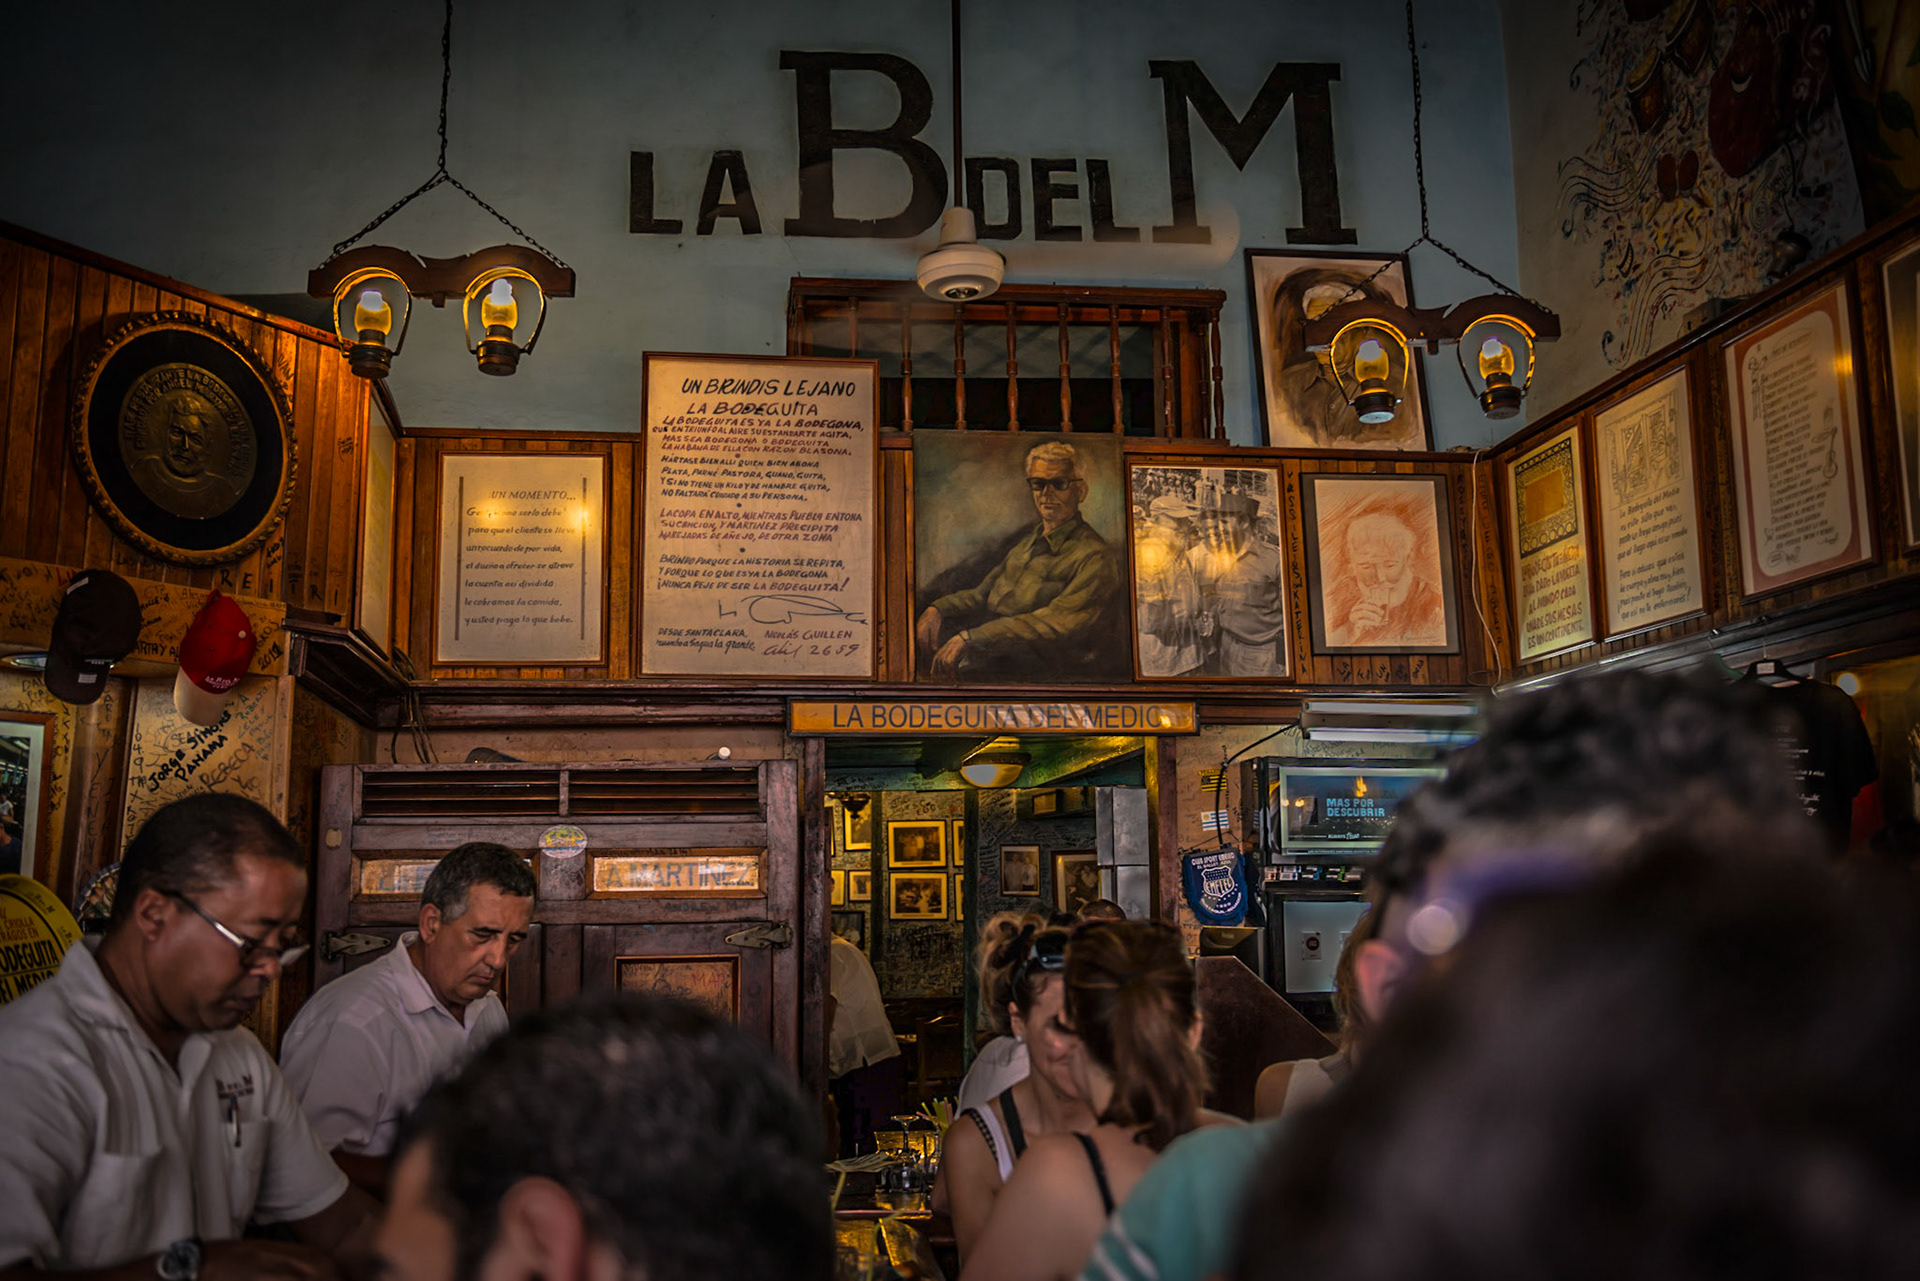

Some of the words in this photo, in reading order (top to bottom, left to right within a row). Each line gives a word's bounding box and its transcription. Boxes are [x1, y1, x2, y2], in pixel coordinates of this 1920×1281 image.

[629, 149, 763, 235] LA
[779, 50, 949, 239] B
[964, 157, 1141, 242] DEL
[1148, 60, 1358, 244] M
[682, 378, 702, 394] UN
[704, 378, 780, 396] BRINDIS
[783, 380, 856, 397] LEJANO
[686, 402, 707, 414] LA
[676, 416, 741, 426] BODEGUITA
[758, 419, 771, 427] YA
[776, 419, 791, 428] LA
[684, 425, 717, 434] TRIUNFO
[729, 427, 748, 435] AIRE
[762, 429, 817, 438] ESTANDARTE
[674, 443, 708, 451] HABANA
[683, 435, 702, 443] SEA
[704, 436, 758, 444] BODEGONA
[771, 438, 830, 447] BODEGUITA
[700, 457, 722, 465] BIEN
[738, 459, 763, 468] QUIEN
[789, 460, 820, 468] ABONA
[660, 477, 667, 485] Y
[667, 478, 677, 486] SI
[678, 479, 688, 487] NO
[690, 480, 713, 489] TIENE
[714, 481, 725, 490] UN
[491, 490, 506, 499] UN
[661, 488, 674, 497] NO
[741, 491, 749, 500] A
[750, 491, 761, 500] SU
[673, 509, 697, 518] COPA
[698, 509, 714, 518] EN
[825, 511, 863, 521] ENTONA
[468, 527, 489, 537] para
[514, 526, 543, 534] cliente
[660, 520, 675, 528] SU
[719, 521, 727, 529] Y
[779, 521, 840, 532] PRECIPITA
[709, 532, 721, 540] DE
[758, 532, 770, 540] DE
[771, 533, 799, 541] OTRA
[803, 533, 833, 542] ZONA
[695, 557, 730, 567] PORQUE
[792, 558, 805, 566] SE
[659, 566, 665, 576] Y
[664, 567, 700, 578] PORQUE
[702, 569, 714, 578] LO
[714, 569, 734, 579] QUE
[735, 570, 747, 578] ES
[761, 570, 774, 578] LA
[775, 570, 829, 579] BODEGONA
[474, 580, 503, 588] cuenta
[716, 581, 729, 590] DE
[729, 582, 750, 591] SER
[753, 581, 768, 591] LA
[473, 598, 515, 606] cobramos
[516, 597, 527, 606] la
[471, 615, 494, 623] usted
[495, 617, 520, 627] paga
[522, 615, 530, 623] lo
[530, 617, 548, 626] que
[657, 627, 684, 637] DESDE
[802, 629, 853, 641] GUILLEN
[833, 704, 865, 728] LA
[870, 703, 1018, 729] BODEGUITA
[1029, 704, 1077, 728] DEL
[1083, 704, 1164, 729] MEDIO
[174, 734, 229, 782] PANAMA
[148, 748, 186, 793] JORGE
[1325, 797, 1350, 808] MAS
[1352, 798, 1375, 808] POR
[1326, 807, 1386, 818] DESCUBRIR
[605, 863, 623, 889] A
